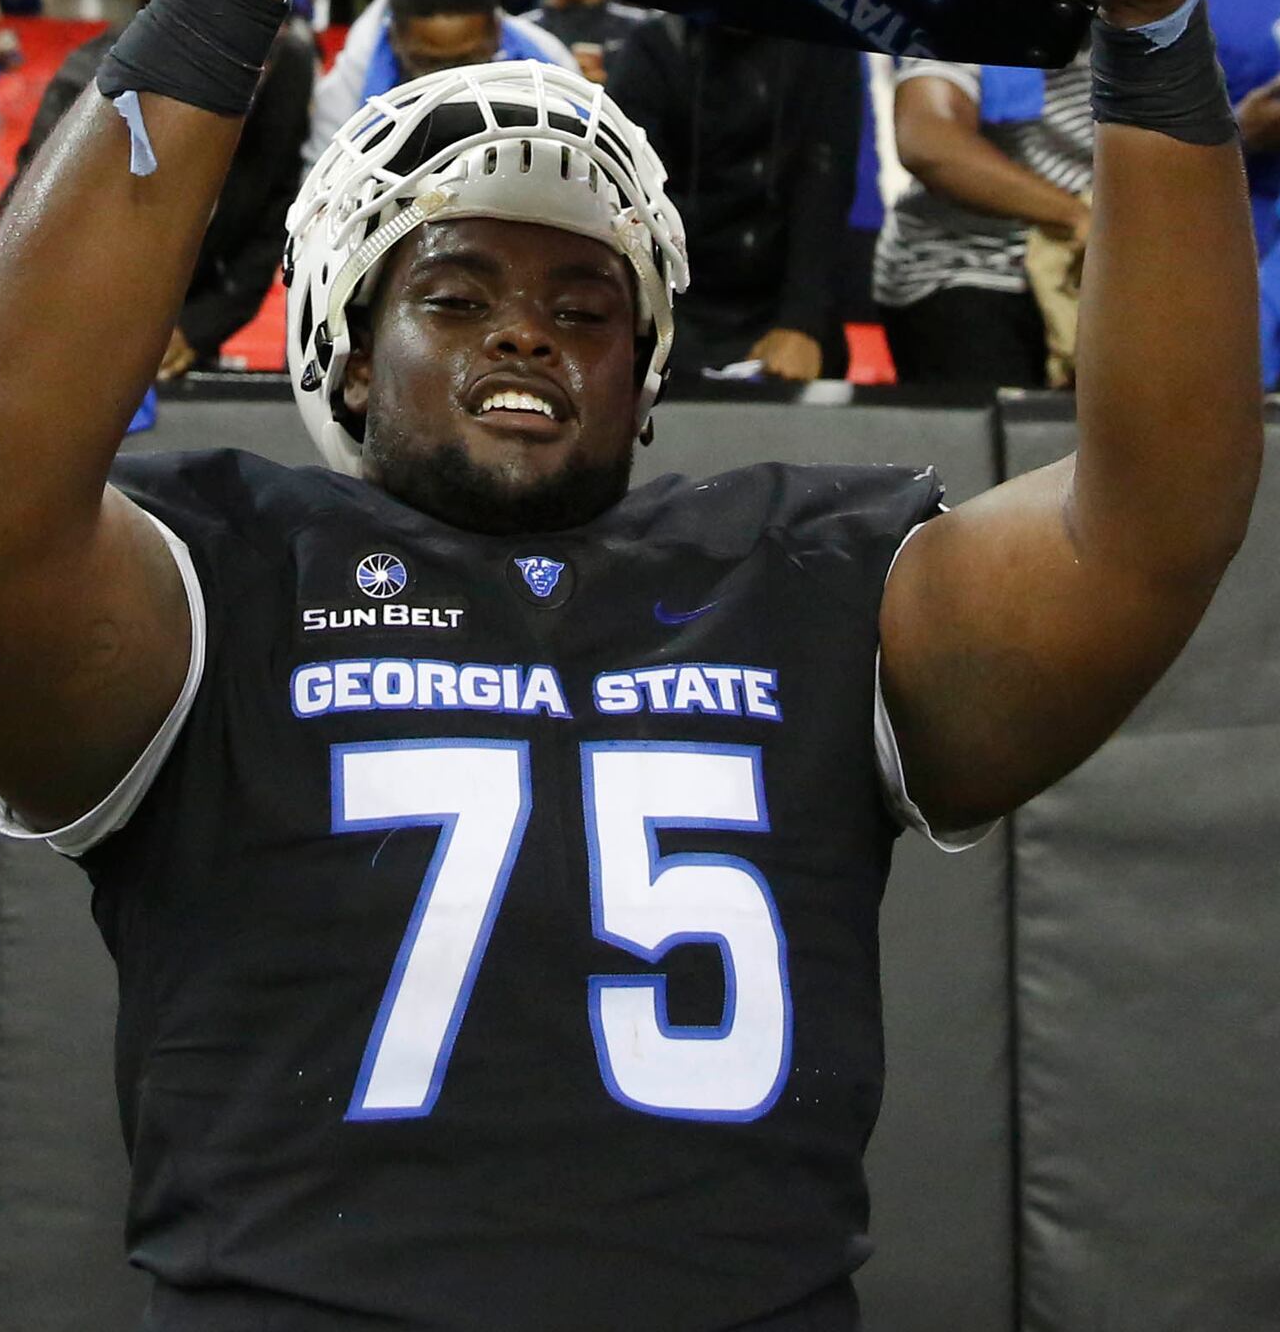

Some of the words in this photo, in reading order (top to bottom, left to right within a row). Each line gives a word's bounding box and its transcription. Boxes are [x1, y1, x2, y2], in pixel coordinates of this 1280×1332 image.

[302, 607, 377, 631] SUN
[382, 603, 464, 629] BELT
[291, 658, 574, 719] GEORGIA
[593, 663, 783, 722] STATE
[330, 737, 794, 1123] 75
